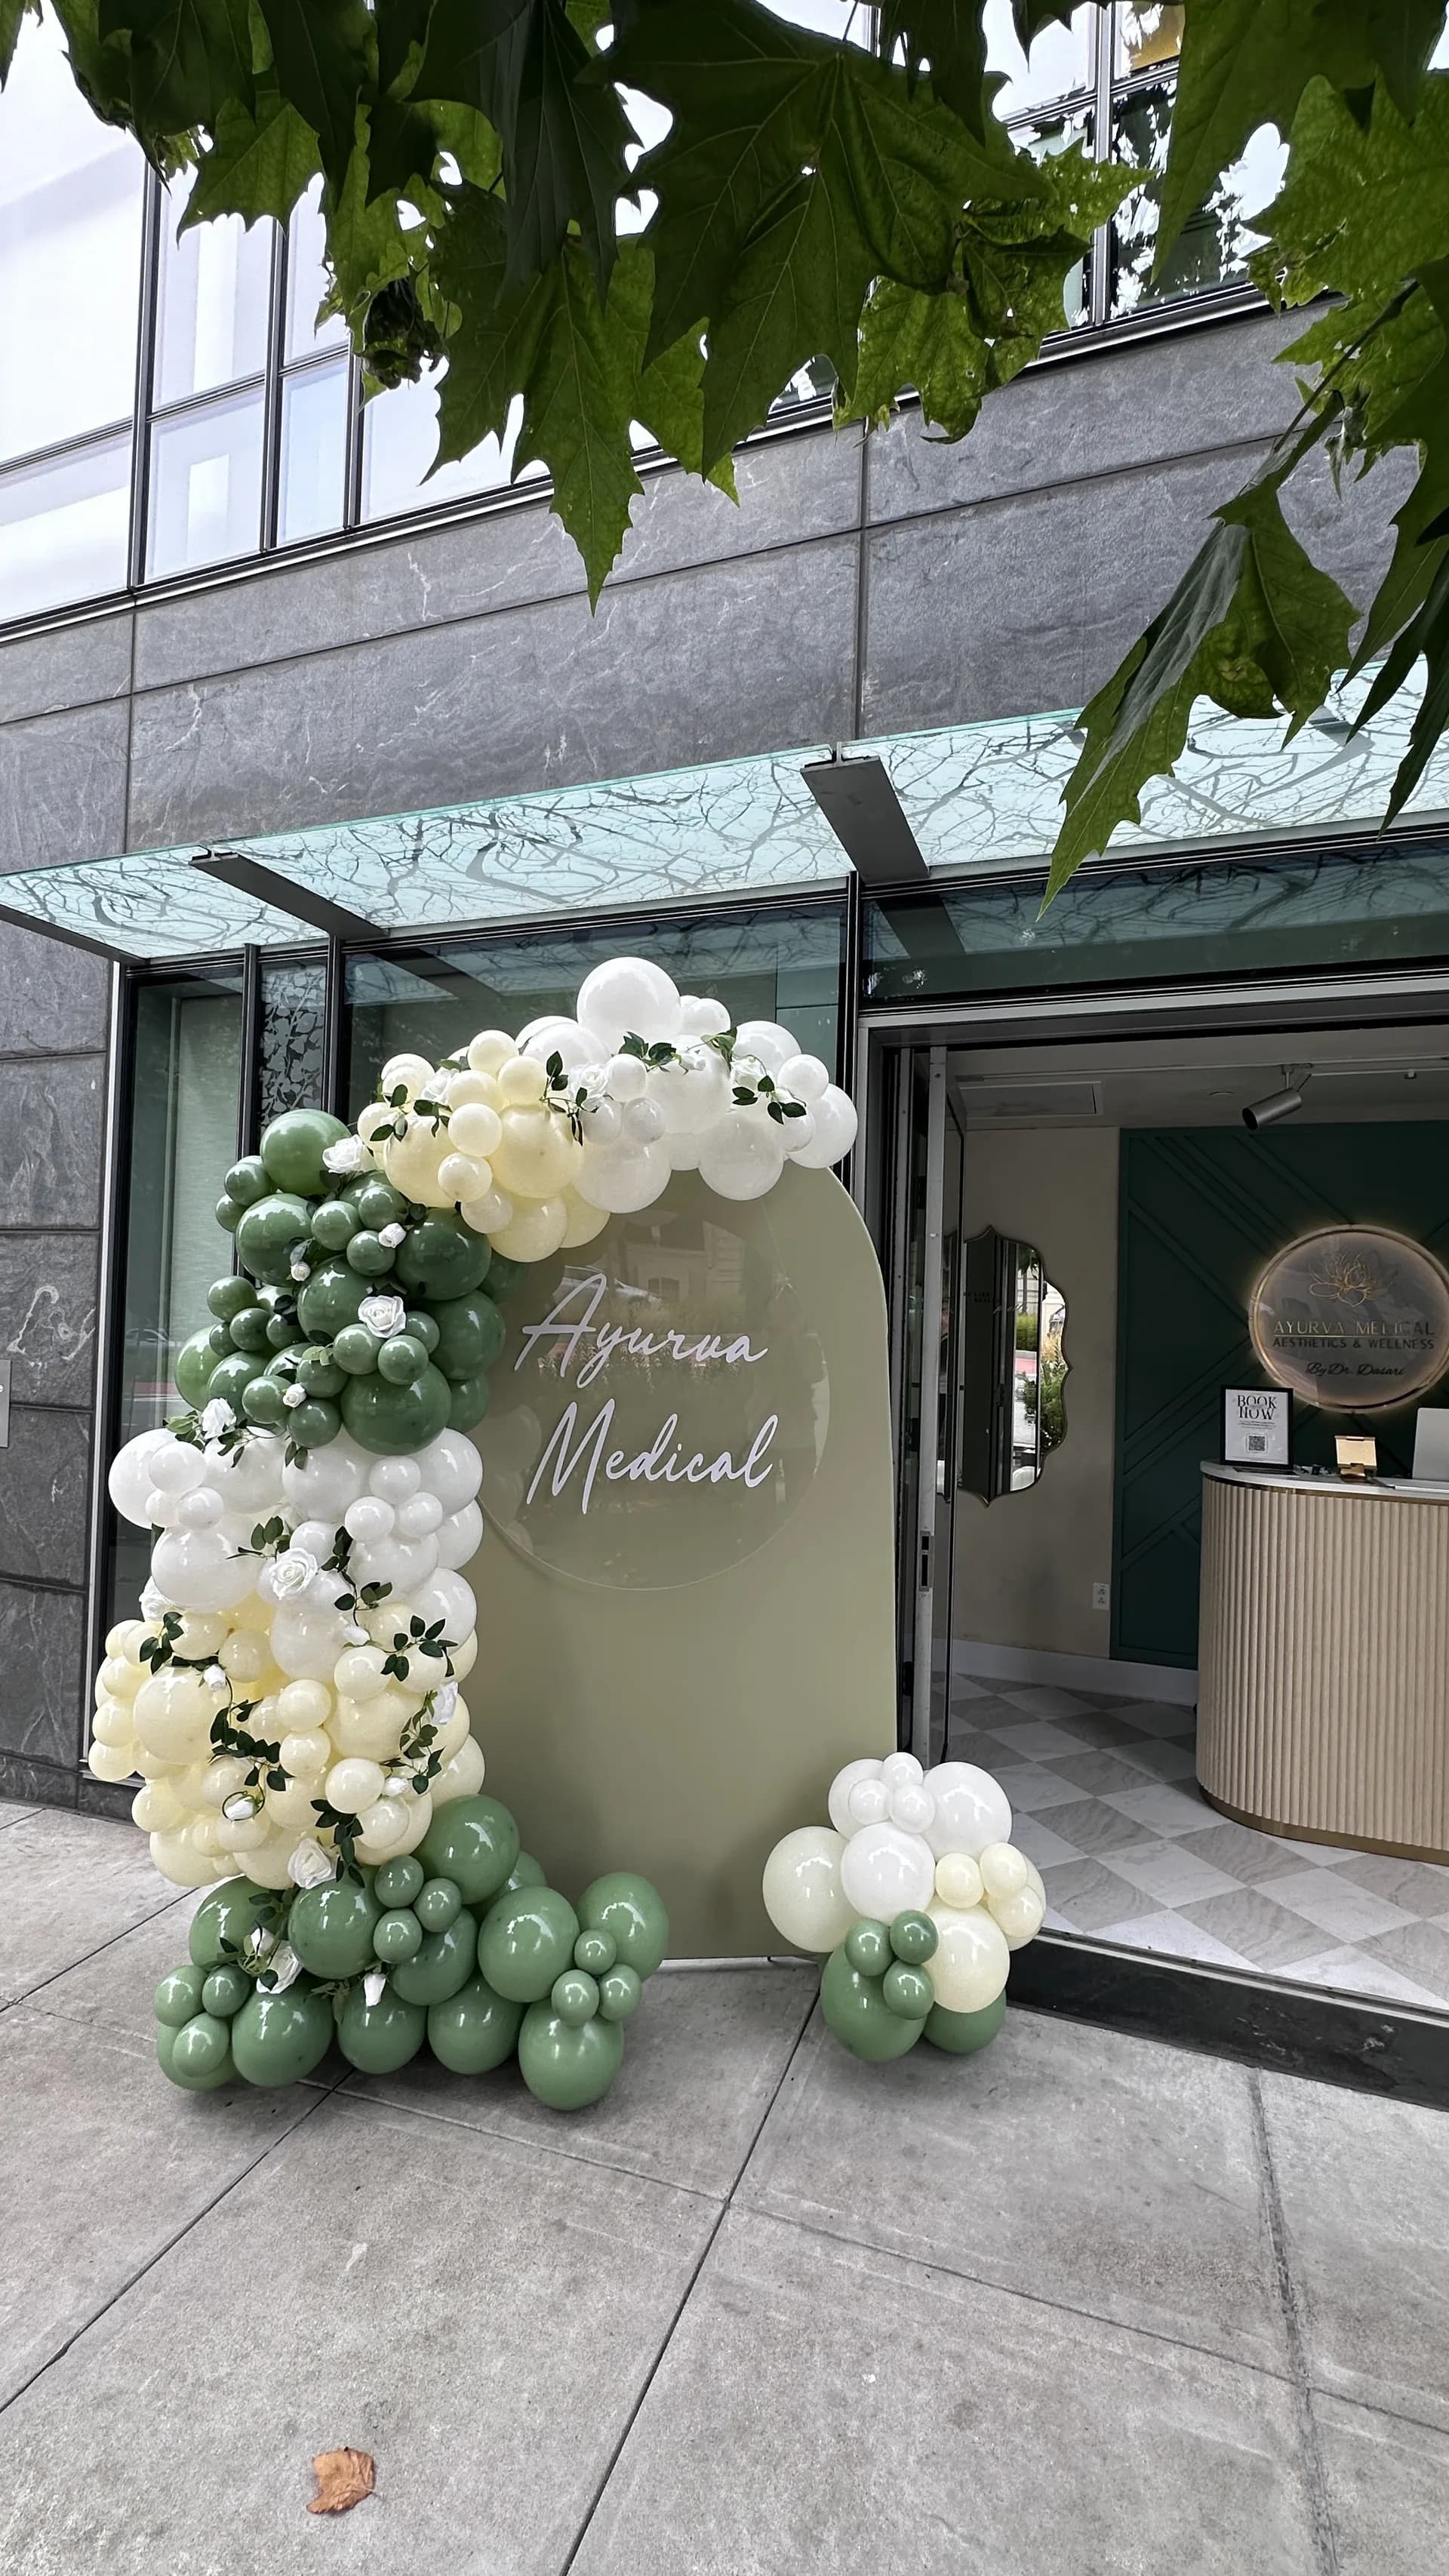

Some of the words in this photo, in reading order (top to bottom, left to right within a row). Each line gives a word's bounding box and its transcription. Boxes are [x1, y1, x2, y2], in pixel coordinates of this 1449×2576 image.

[514, 1273, 768, 1389] Ayurva
[1274, 1320, 1346, 1334] AYURVA
[1272, 1337, 1347, 1348] AESTHETICS
[1352, 1340, 1361, 1348] &
[1368, 1338, 1435, 1350] WELLNESS
[1306, 1362, 1327, 1377] By
[1357, 1363, 1405, 1376] Dasari
[1238, 1395, 1276, 1408] BOOK
[1239, 1406, 1275, 1420] NOW
[526, 1399, 778, 1514] Medical
